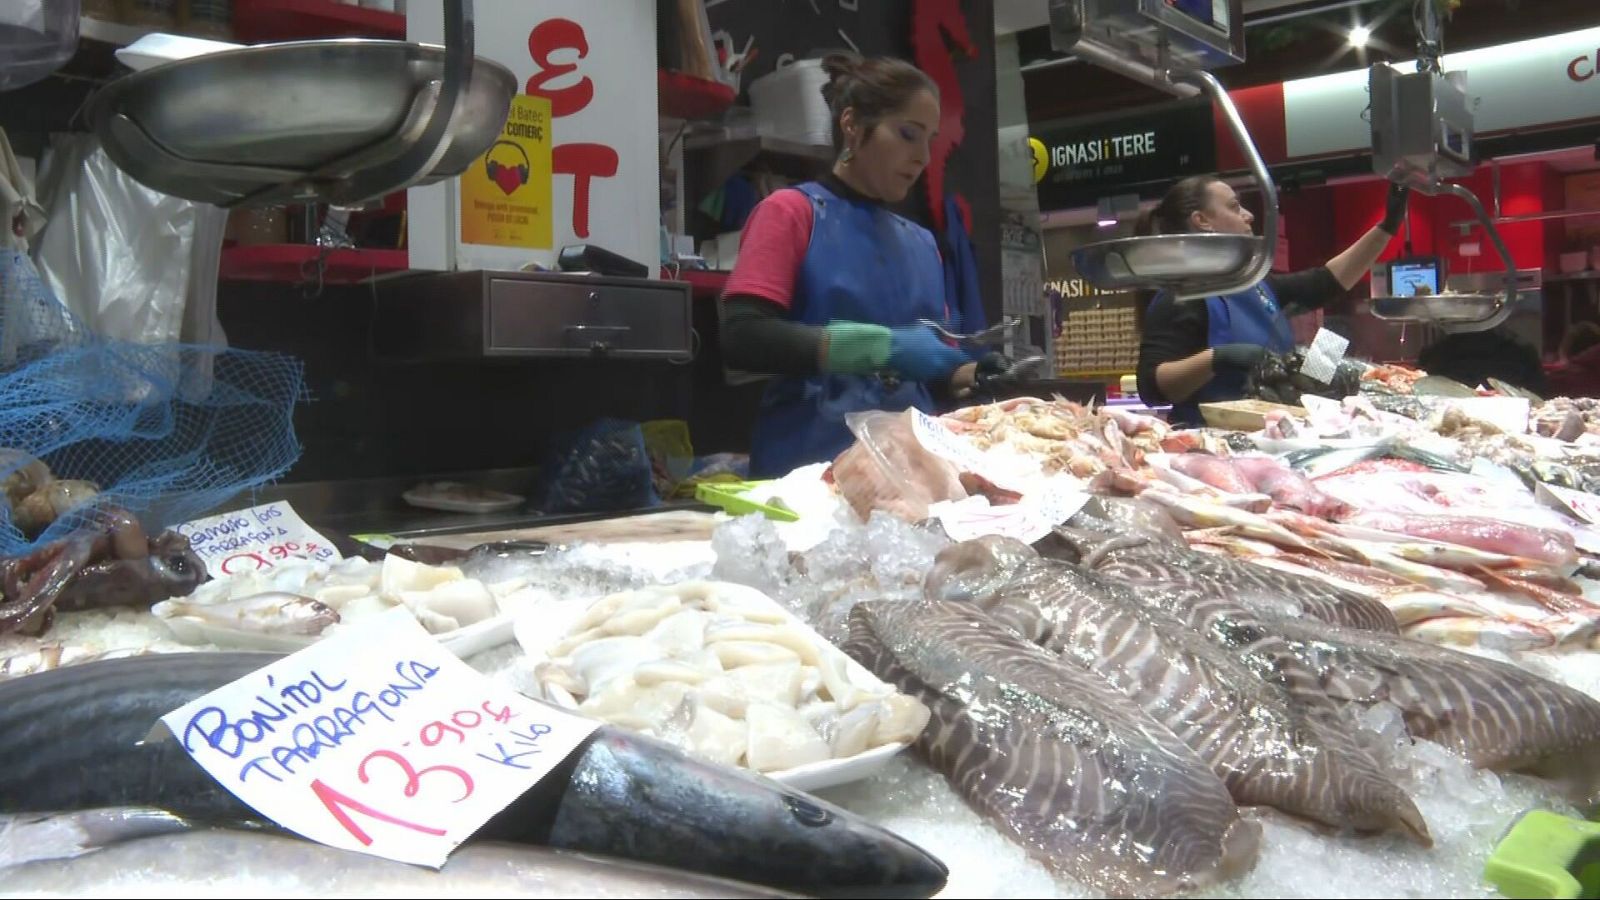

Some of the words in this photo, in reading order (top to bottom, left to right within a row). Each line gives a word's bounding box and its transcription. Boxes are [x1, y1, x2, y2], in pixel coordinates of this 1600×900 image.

[1567, 48, 1600, 82] c
[517, 105, 543, 123] Batec
[507, 122, 543, 143] COMERÇ
[1052, 139, 1103, 167] IGNASI
[1112, 131, 1156, 158] TERE
[239, 661, 440, 782] TARRAGONA
[476, 724, 552, 769] Kilo
